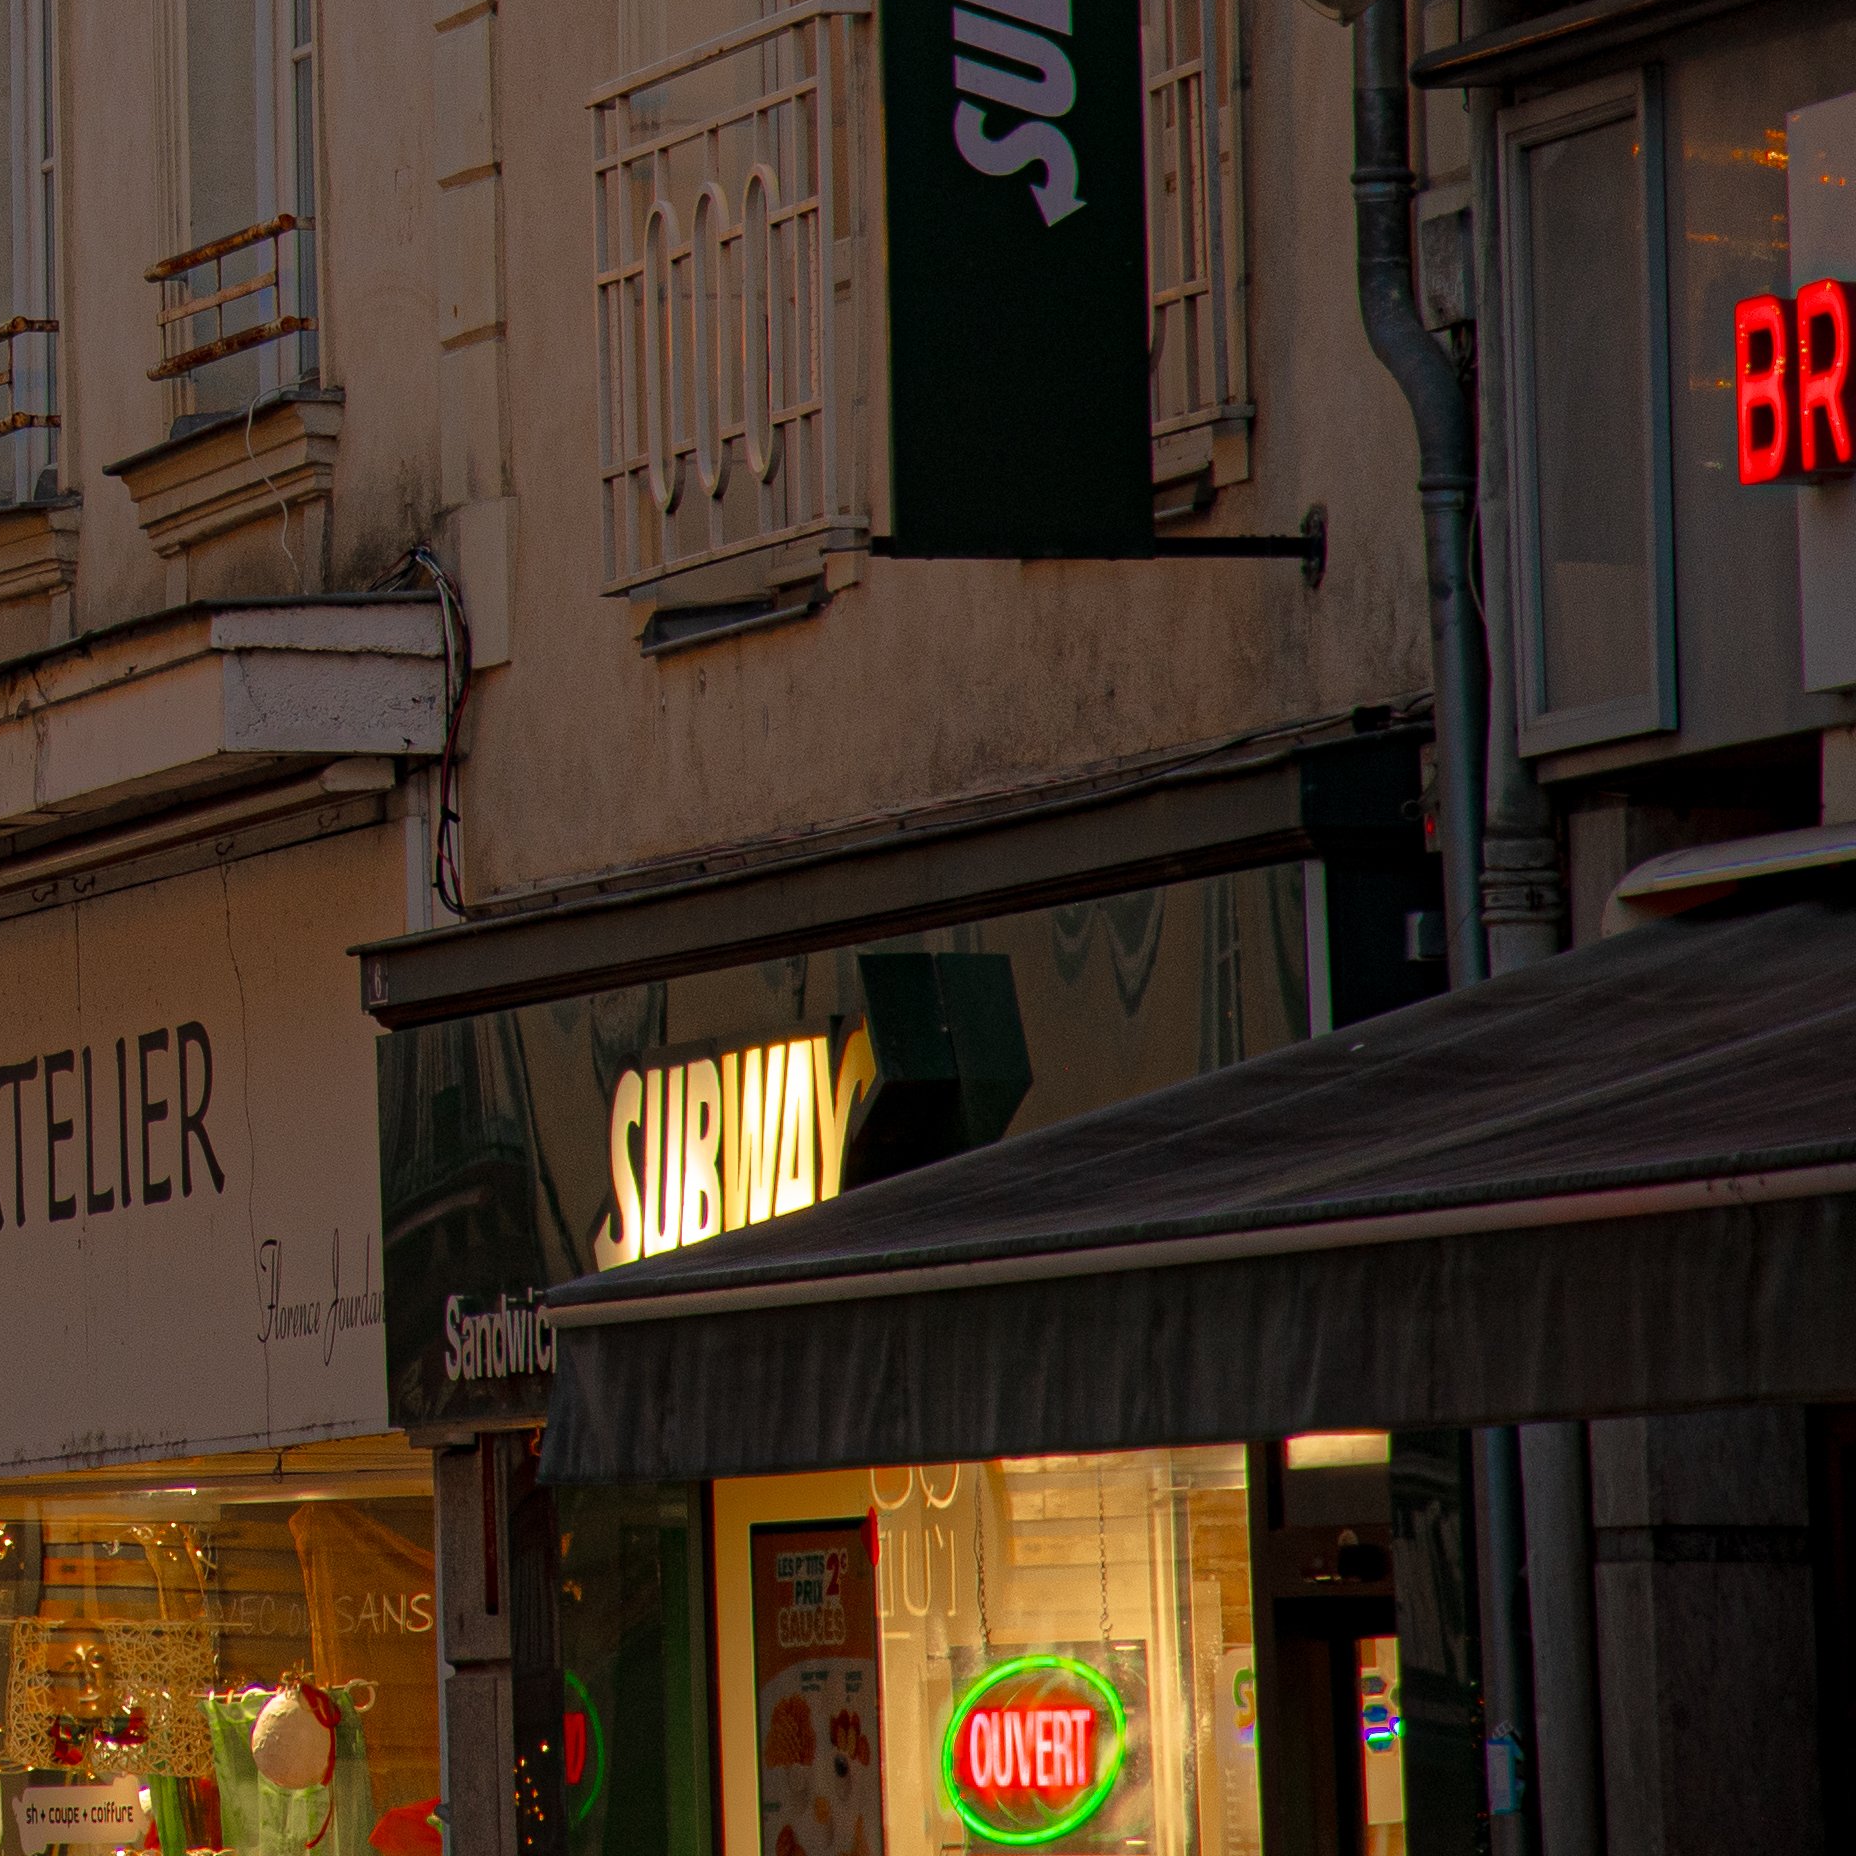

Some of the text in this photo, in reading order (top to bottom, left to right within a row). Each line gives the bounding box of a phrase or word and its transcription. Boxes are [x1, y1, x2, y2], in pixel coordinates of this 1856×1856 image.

[592, 1017, 878, 1272] SUBWAY
[257, 1238, 321, 1343] Florence
[334, 1592, 434, 1634] SANS
[969, 1708, 1092, 1789] OUVERT
